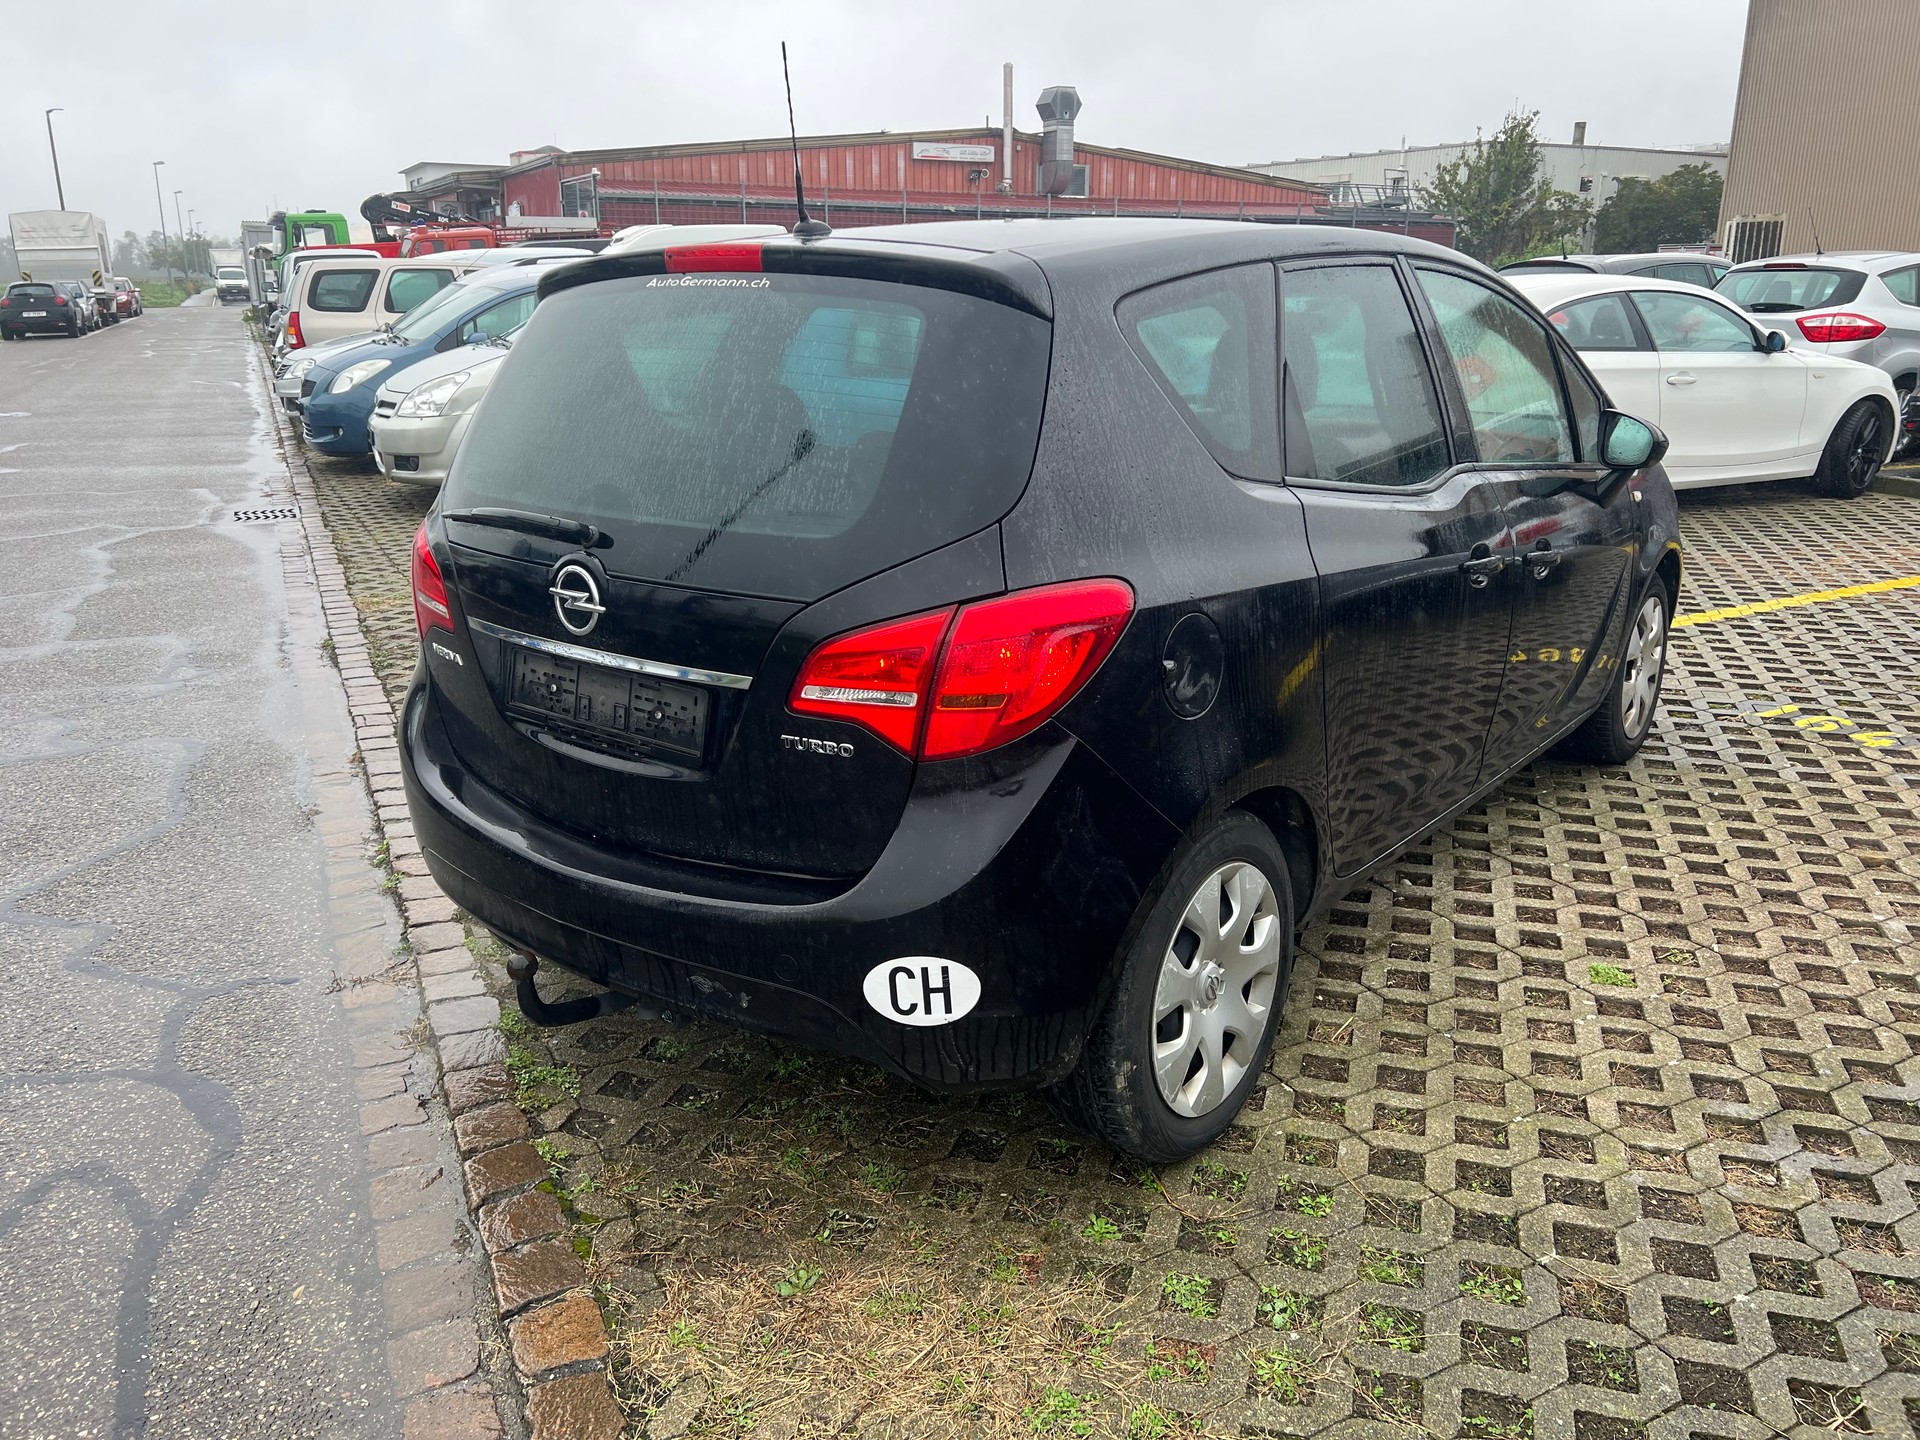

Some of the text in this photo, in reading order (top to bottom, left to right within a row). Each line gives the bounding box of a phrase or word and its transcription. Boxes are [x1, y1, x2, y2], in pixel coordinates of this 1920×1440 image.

[646, 276, 771, 288] AutoGermann.ch
[781, 734, 854, 758] TURBO
[888, 966, 952, 1016] CH
